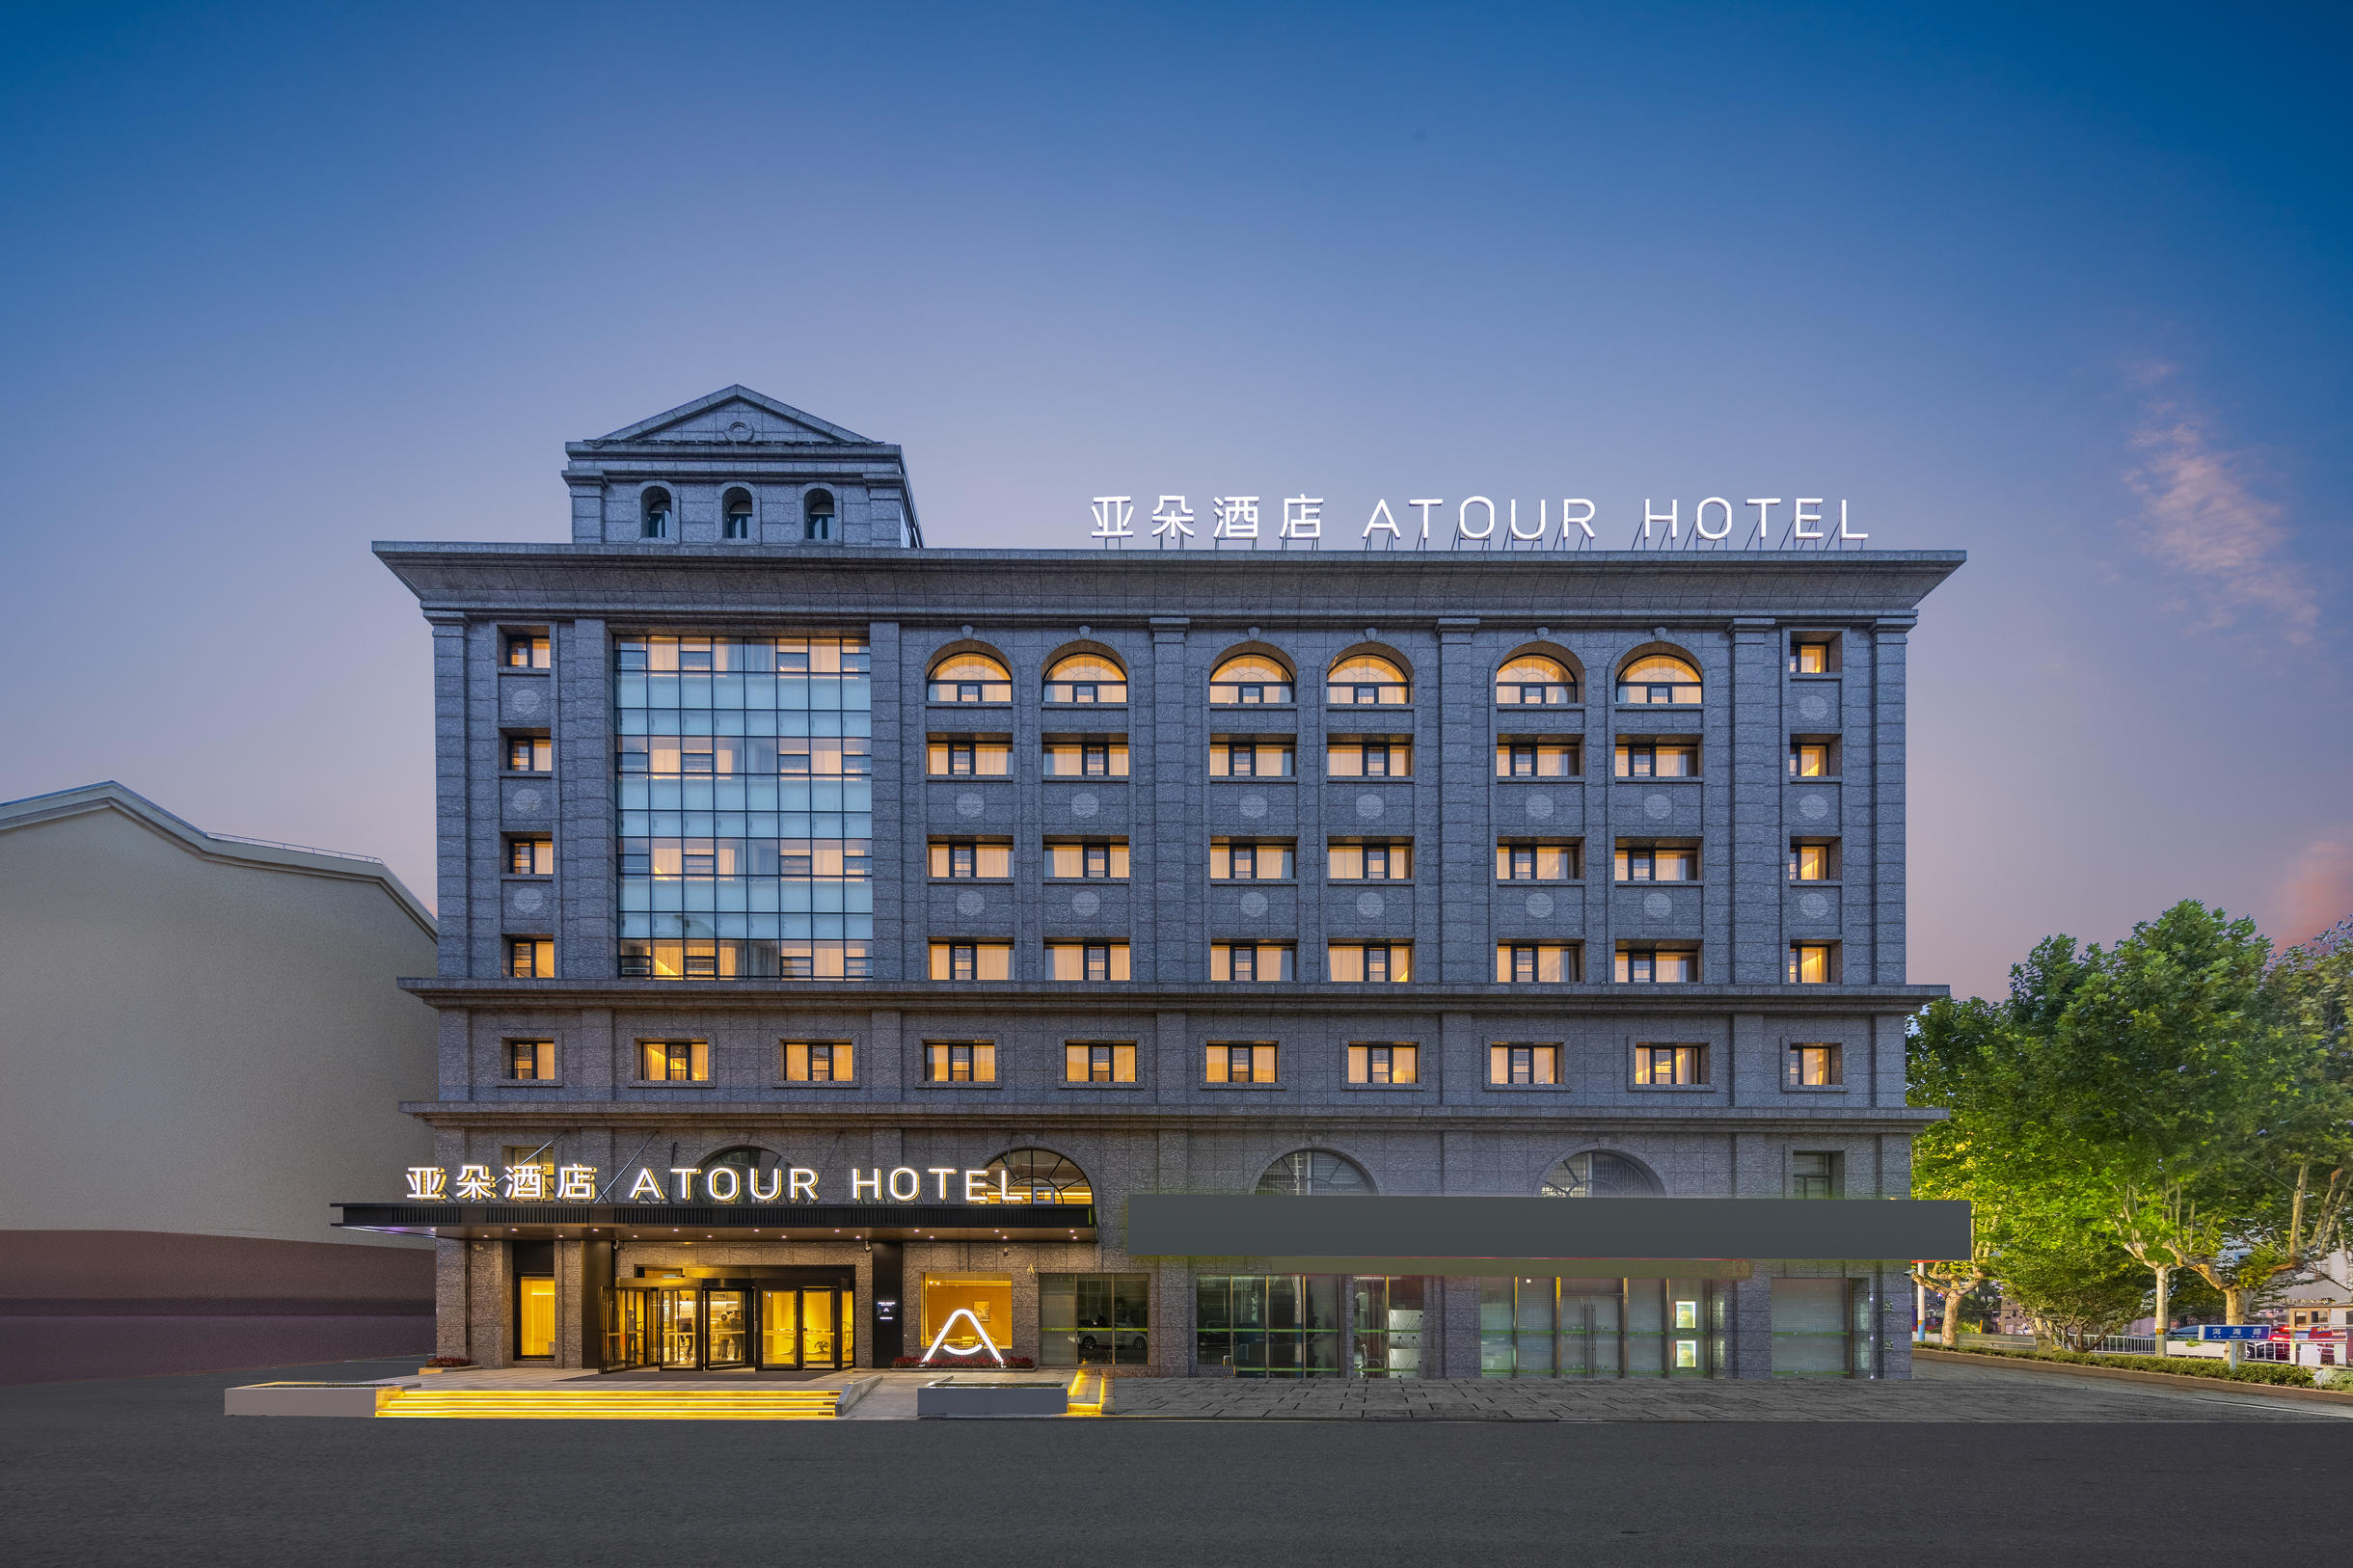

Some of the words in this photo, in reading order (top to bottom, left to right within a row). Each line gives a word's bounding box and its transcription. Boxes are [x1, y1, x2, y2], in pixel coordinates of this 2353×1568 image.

[1091, 494, 1324, 538] 亚朵酒店
[1363, 496, 1596, 539] ATOUR
[1644, 498, 1869, 540] HOTEL
[406, 1163, 597, 1201] 亚朵酒店
[629, 1167, 819, 1201] ATOUR
[852, 1167, 1024, 1202] HOTEL
